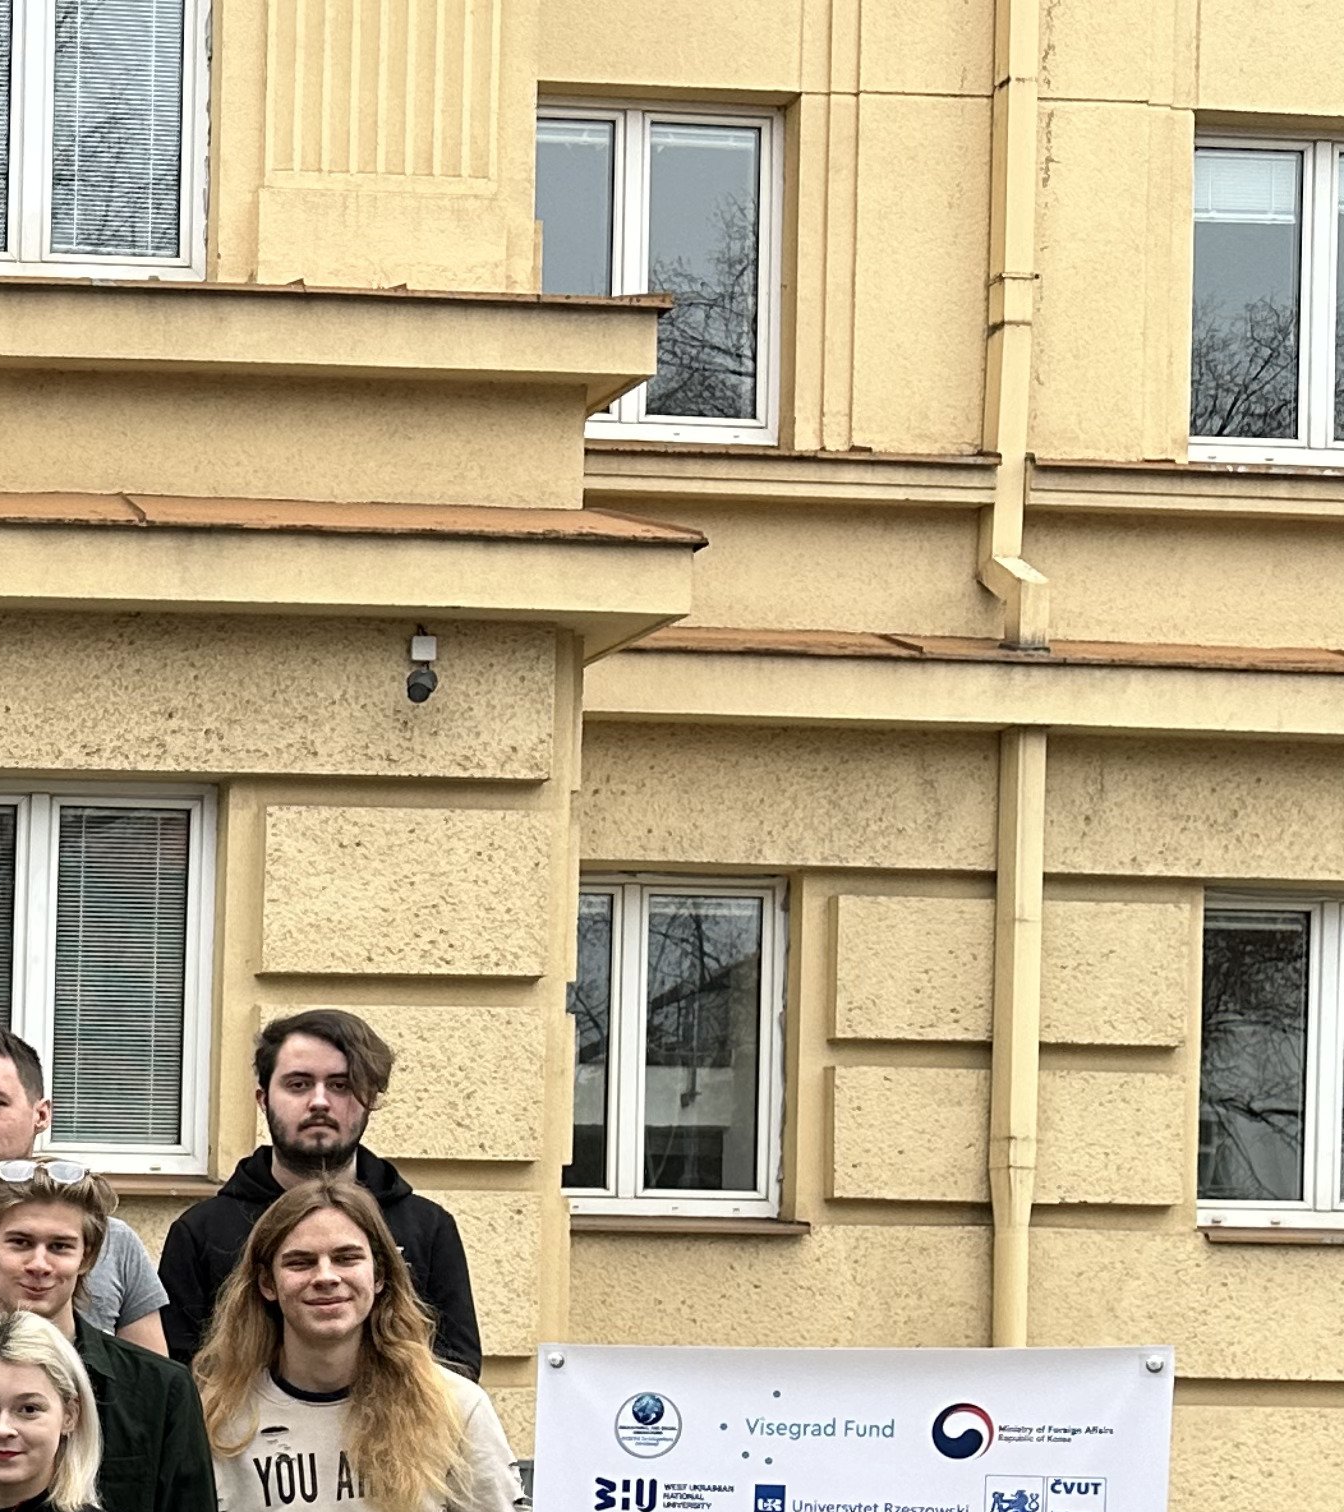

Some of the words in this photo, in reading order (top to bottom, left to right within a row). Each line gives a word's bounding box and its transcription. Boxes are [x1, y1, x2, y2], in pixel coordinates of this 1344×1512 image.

[746, 1417, 836, 1440] Visegrad
[844, 1419, 895, 1438] Fund
[254, 1452, 318, 1507] YOU
[1050, 1478, 1102, 1495] ČVUT
